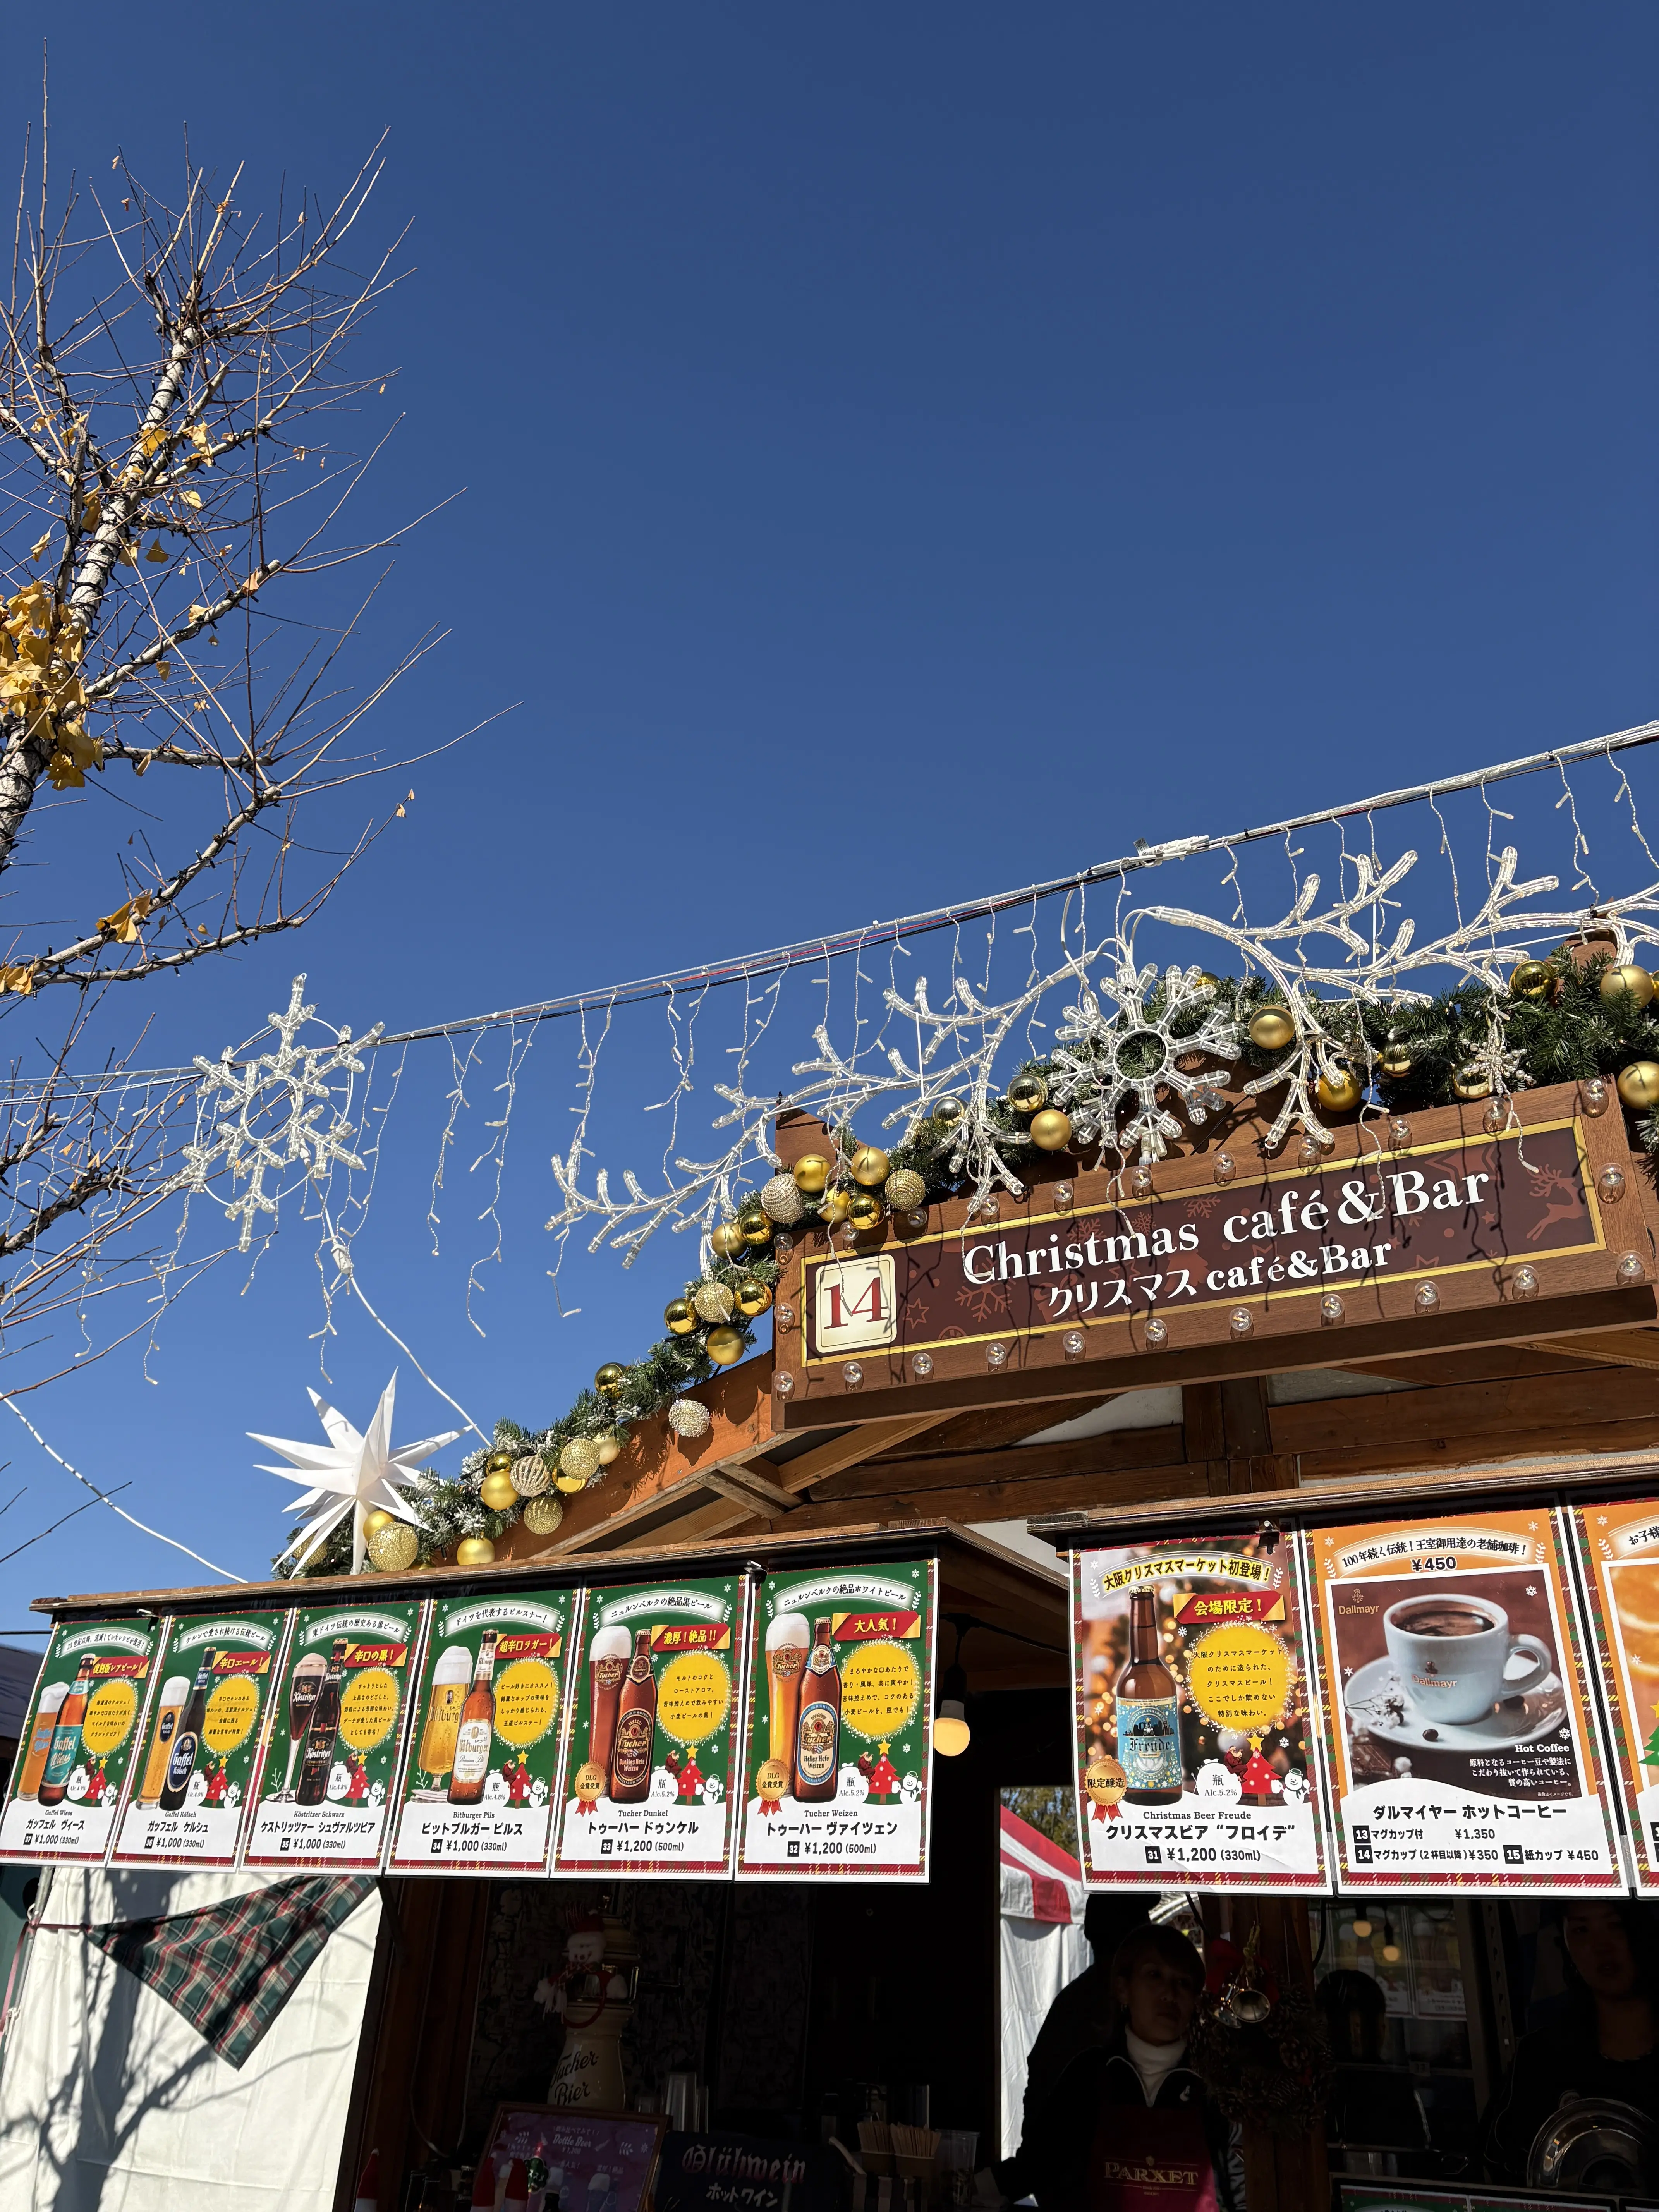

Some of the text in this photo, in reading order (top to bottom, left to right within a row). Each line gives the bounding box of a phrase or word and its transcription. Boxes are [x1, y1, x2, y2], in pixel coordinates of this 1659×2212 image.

[964, 1223, 1199, 1285] Christmas
[1048, 1269, 1197, 1317] クリスマス
[824, 1277, 888, 1329] 14
[1412, 1556, 1456, 1571] ¥450
[1104, 1558, 1269, 1590] 大阪クリスマスマーケット初登場！
[784, 1584, 907, 1606] ニュルンベルクの絶品ホワイトビール
[611, 1596, 713, 1617] ニュルンベルクの絶品黒ビール
[1194, 1598, 1262, 1616] 会場限定！
[1338, 1604, 1379, 1615] Dallmayr
[457, 1608, 547, 1626] ドイツを代表するピルスナー！
[312, 1618, 400, 1638] 東ドイツ伝統の歴史ある黒ビール
[854, 1618, 896, 1633] 大人気！
[499, 1638, 553, 1653] 超辛口ラガー！
[354, 1649, 394, 1662] 辛口の黒！
[1194, 1647, 1282, 1659] 大阪クリスマスマーケット
[850, 1666, 909, 1674] まろやかな口あたりで
[1208, 1664, 1271, 1672] のために造られた、
[1207, 1678, 1272, 1687] クリスマスビール！
[1412, 1674, 1457, 1688] Dallmayr
[1209, 1693, 1276, 1702] ここでしか飲めない
[53, 1736, 76, 1751] Gaffel
[622, 1739, 647, 1747] Tucher
[1515, 1743, 1570, 1753] Hot Coffee
[172, 1752, 194, 1766] Gaffel
[1470, 1757, 1571, 1767] 原料となるコーヒー豆や製法に
[1472, 1768, 1570, 1777] こだわり抜いて作られている、
[492, 1782, 500, 1791] 瓶
[658, 1779, 666, 1789] 瓶
[846, 1777, 855, 1787] 瓶
[1087, 1778, 1125, 1789] 限定醸造
[1212, 1774, 1224, 1786] 瓶
[1508, 1778, 1571, 1787] 質の高いコーヒー。
[1204, 1788, 1238, 1797] Alc.5.2%
[1143, 1811, 1251, 1820] Christmas Beer Freude
[1373, 1805, 1567, 1820] ダルマイヤー ホットコーヒー
[26, 1819, 85, 1831] ガッフェル ヴィース
[147, 1820, 208, 1833] ガッフェル ケルシュ
[261, 1821, 375, 1834] ケストリッツァー シュヴァルツビア
[422, 1822, 523, 1835] ビットブルガー ピルス
[589, 1821, 699, 1834] トゥーハー ドゥンケル
[768, 1821, 898, 1836] トゥーハー ヴァイツェン
[34, 1834, 58, 1844] ¥1,000
[60, 1836, 79, 1844] (330ml)
[1106, 1825, 1209, 1840] クリスマスビア
[1355, 1829, 1495, 1840] 13 マグカップ付 ¥1,350
[156, 1837, 182, 1848] ¥1,000
[183, 1839, 204, 1848] (330ml)
[281, 1839, 346, 1850] 35 ¥1,000 (330ml)
[446, 1840, 479, 1852] ¥1,000
[481, 1842, 507, 1851] (330ml)
[603, 1840, 684, 1852] 33 ¥1,200 (500ml)
[789, 1842, 876, 1855] 32 ¥1,200 (500ml)
[1147, 1848, 1261, 1862] 31 ¥1,200 (330ml)
[1358, 1850, 1370, 1860] 14
[1505, 1850, 1520, 1860] 15
[1525, 1849, 1563, 1861] 紙カップ
[1568, 1850, 1599, 1861] ¥450
[555, 2082, 590, 2106] Bier
[1104, 2162, 1199, 2185] PARXET
